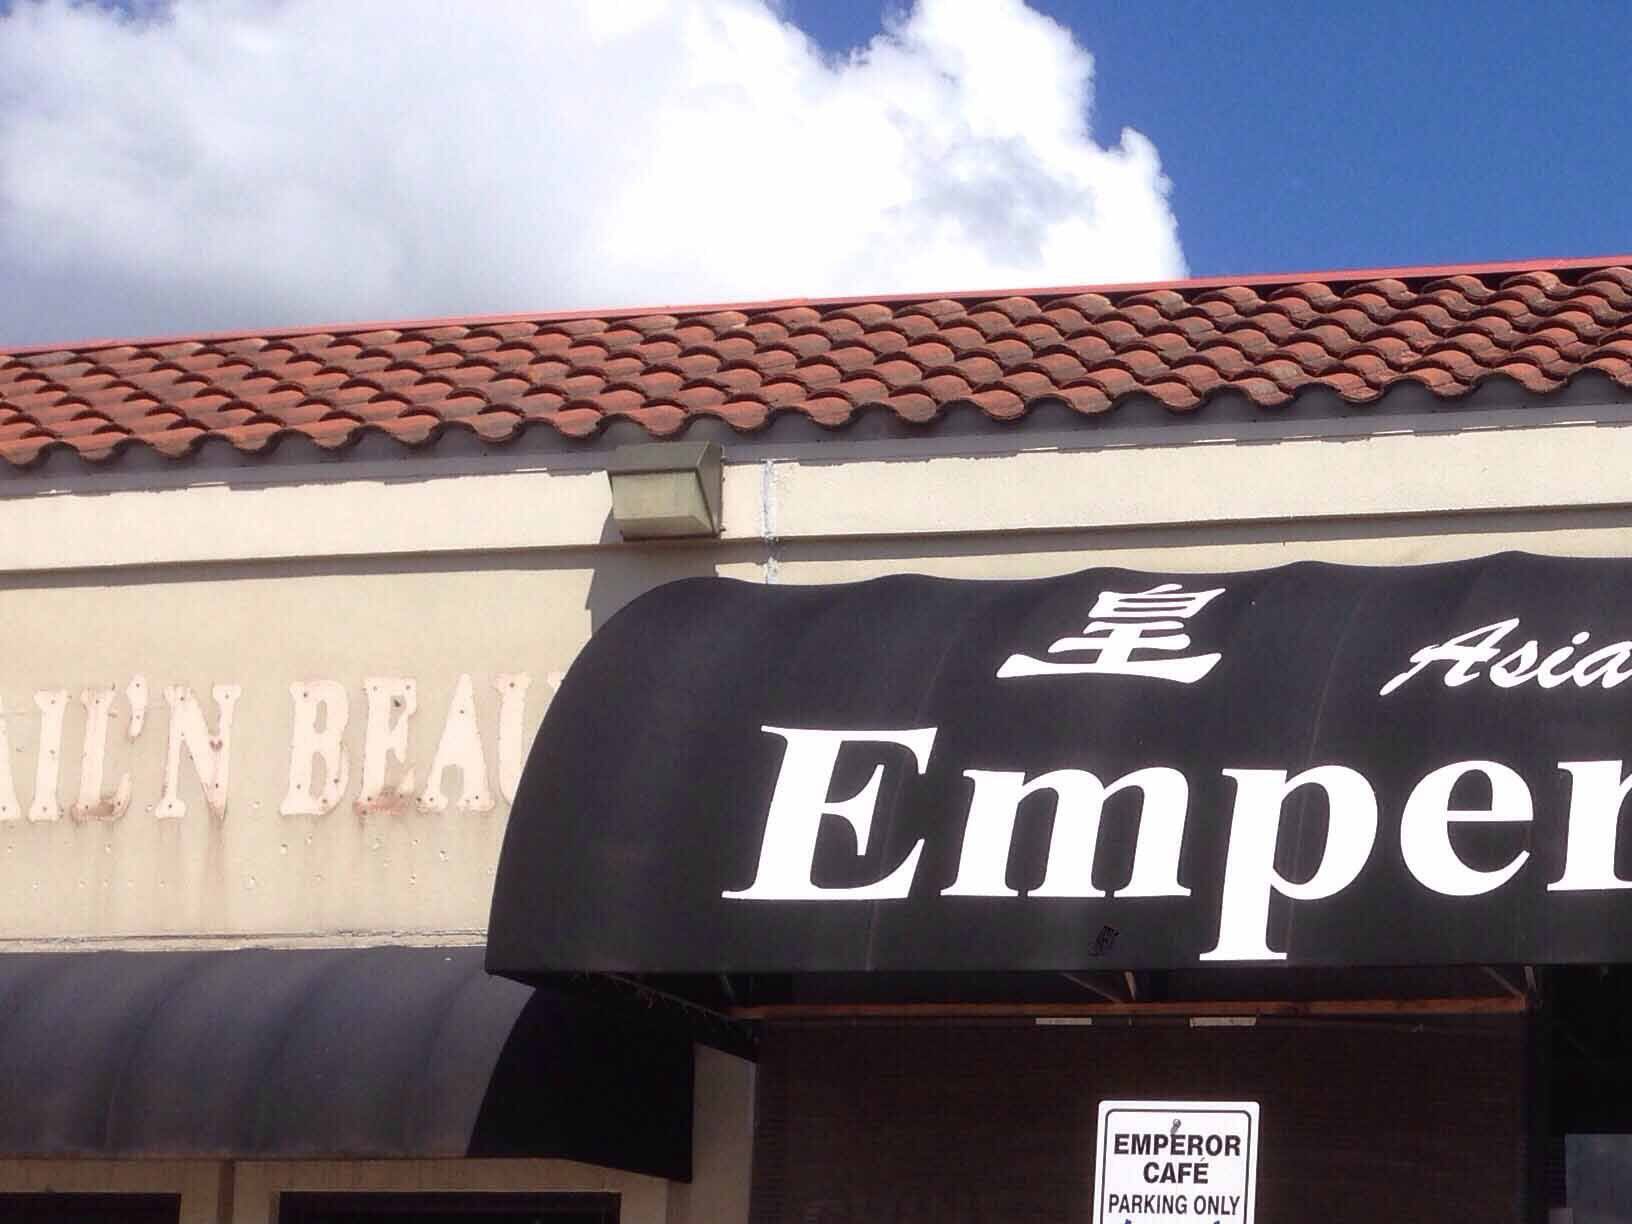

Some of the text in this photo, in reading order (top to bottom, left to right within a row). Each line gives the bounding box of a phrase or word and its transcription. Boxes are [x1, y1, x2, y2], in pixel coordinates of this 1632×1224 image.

[996, 584, 1226, 683] 皇
[0, 672, 242, 822] IL'N
[1114, 1133, 1242, 1157] EMPEROR
[1108, 1193, 1241, 1216] PARKING ONLY
